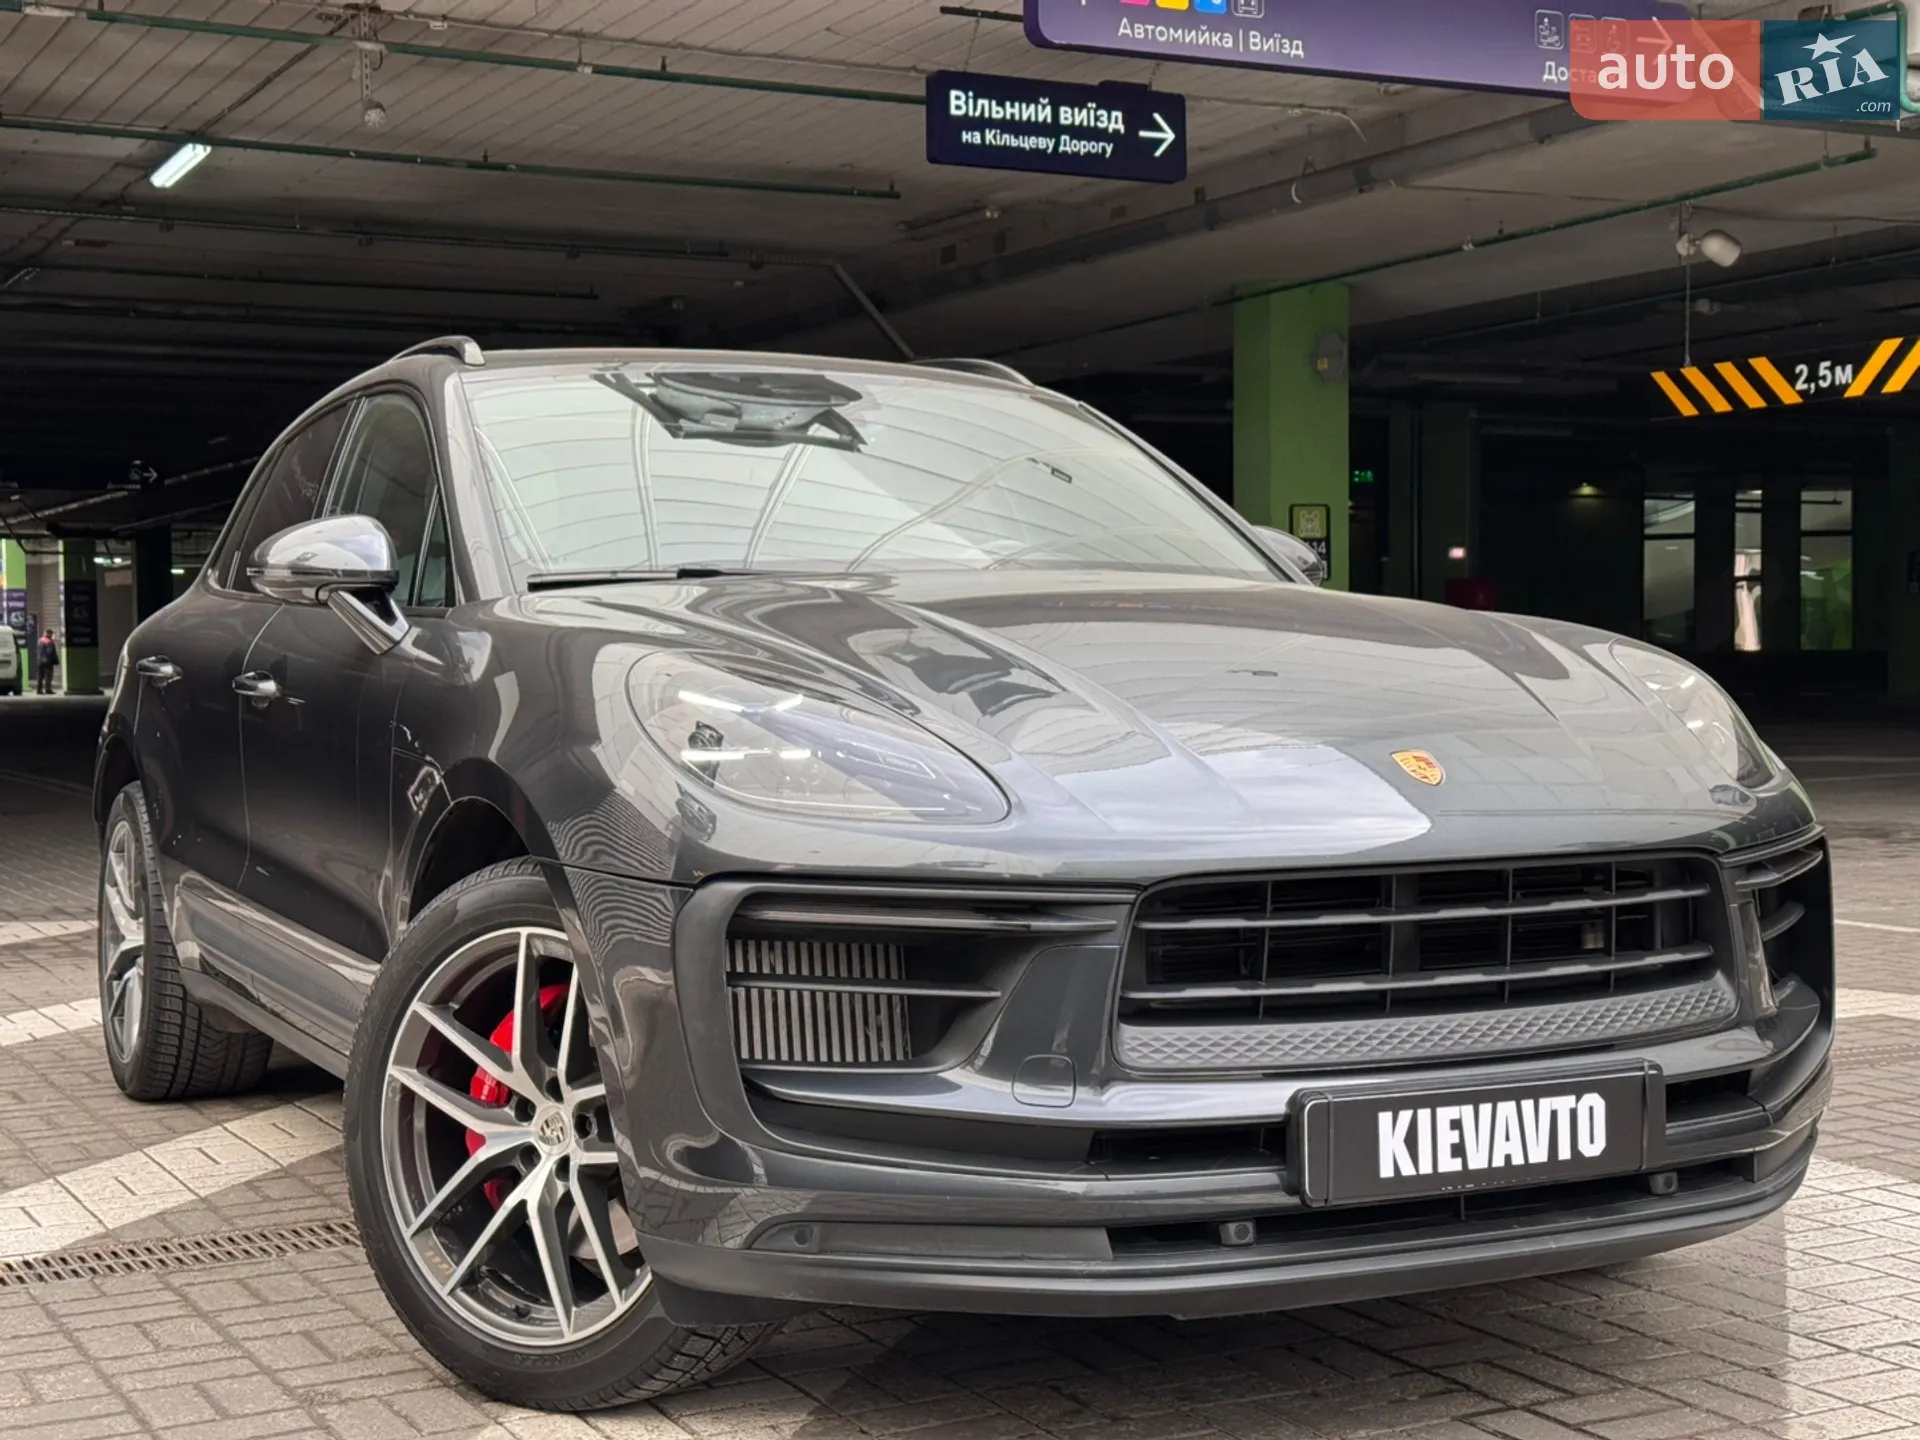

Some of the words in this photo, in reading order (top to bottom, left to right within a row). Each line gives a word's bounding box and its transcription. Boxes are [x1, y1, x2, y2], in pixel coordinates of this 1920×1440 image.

[1118, 17, 1233, 48] Автомийка
[1249, 30, 1304, 59] Виїзд
[949, 89, 1052, 124] Вільний
[1059, 102, 1125, 134] виїзд
[962, 130, 981, 145] на
[985, 128, 1055, 153] Кільцеву
[1059, 135, 1114, 158] Дорогу
[1378, 1092, 1607, 1178] KIEVAVTO
